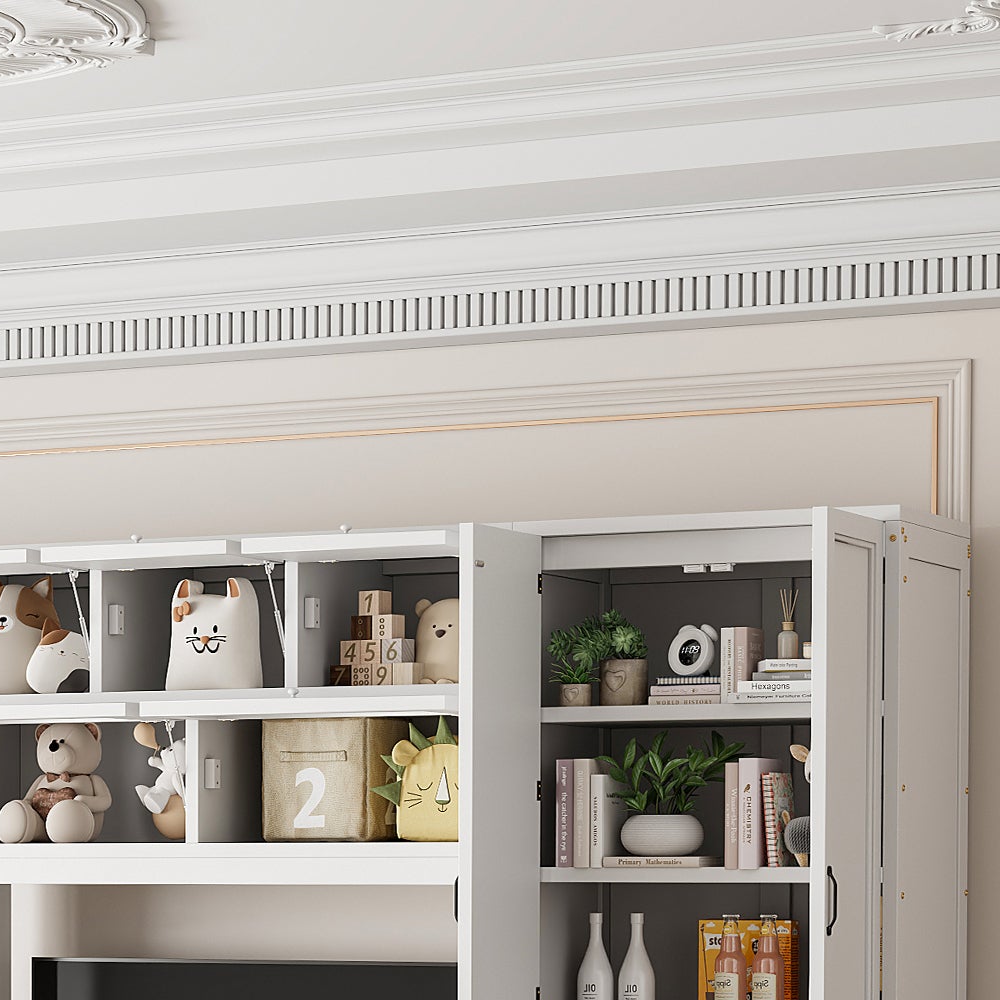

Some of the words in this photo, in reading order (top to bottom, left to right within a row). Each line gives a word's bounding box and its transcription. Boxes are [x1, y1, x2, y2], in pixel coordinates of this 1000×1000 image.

[364, 593, 373, 613] 1
[344, 643, 356, 662] 4
[364, 642, 376, 661] 5
[386, 641, 397, 660] 6
[335, 667, 346, 685] 7
[376, 666, 387, 685] 9
[751, 683, 791, 692] Hexagons
[293, 767, 326, 828] 2
[618, 858, 641, 866] Primary
